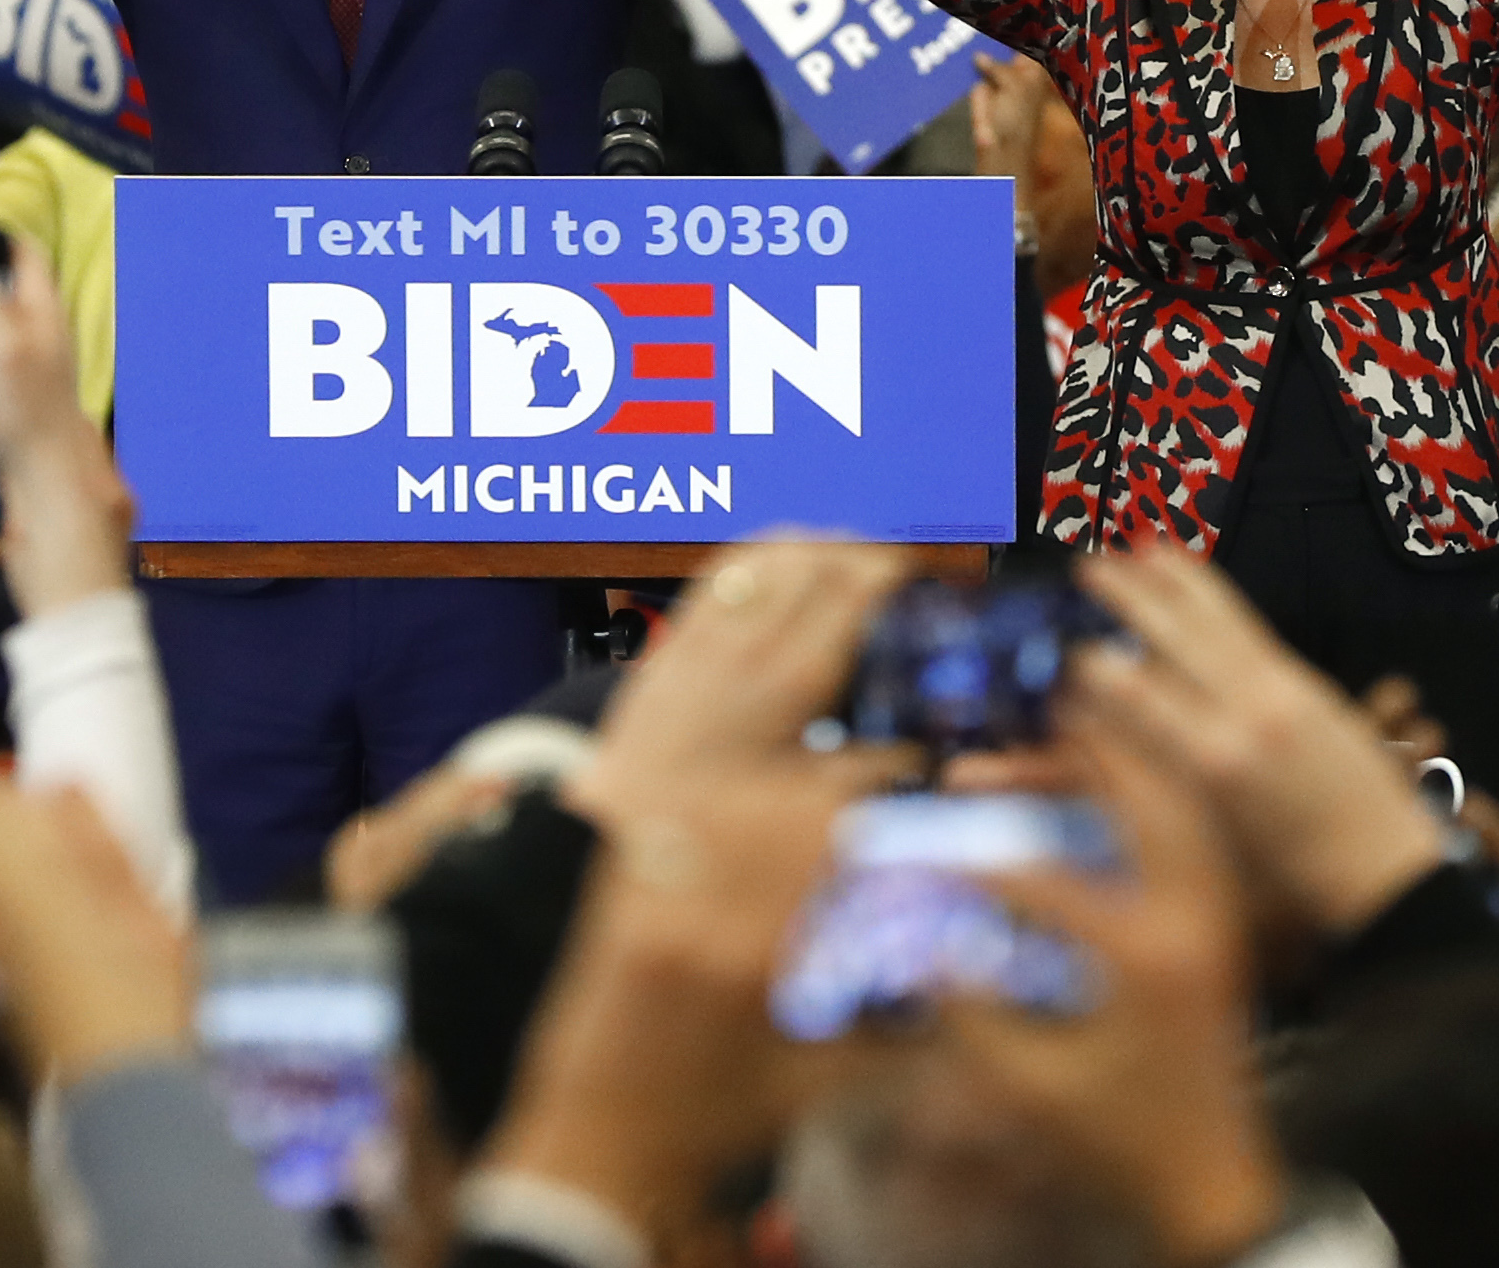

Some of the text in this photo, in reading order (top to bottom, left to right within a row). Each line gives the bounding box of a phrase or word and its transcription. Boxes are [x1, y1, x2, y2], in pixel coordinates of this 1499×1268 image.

[274, 204, 849, 257] Text MI to 30330
[267, 281, 863, 439] BIDEN
[395, 464, 734, 515] MICHIGAN
